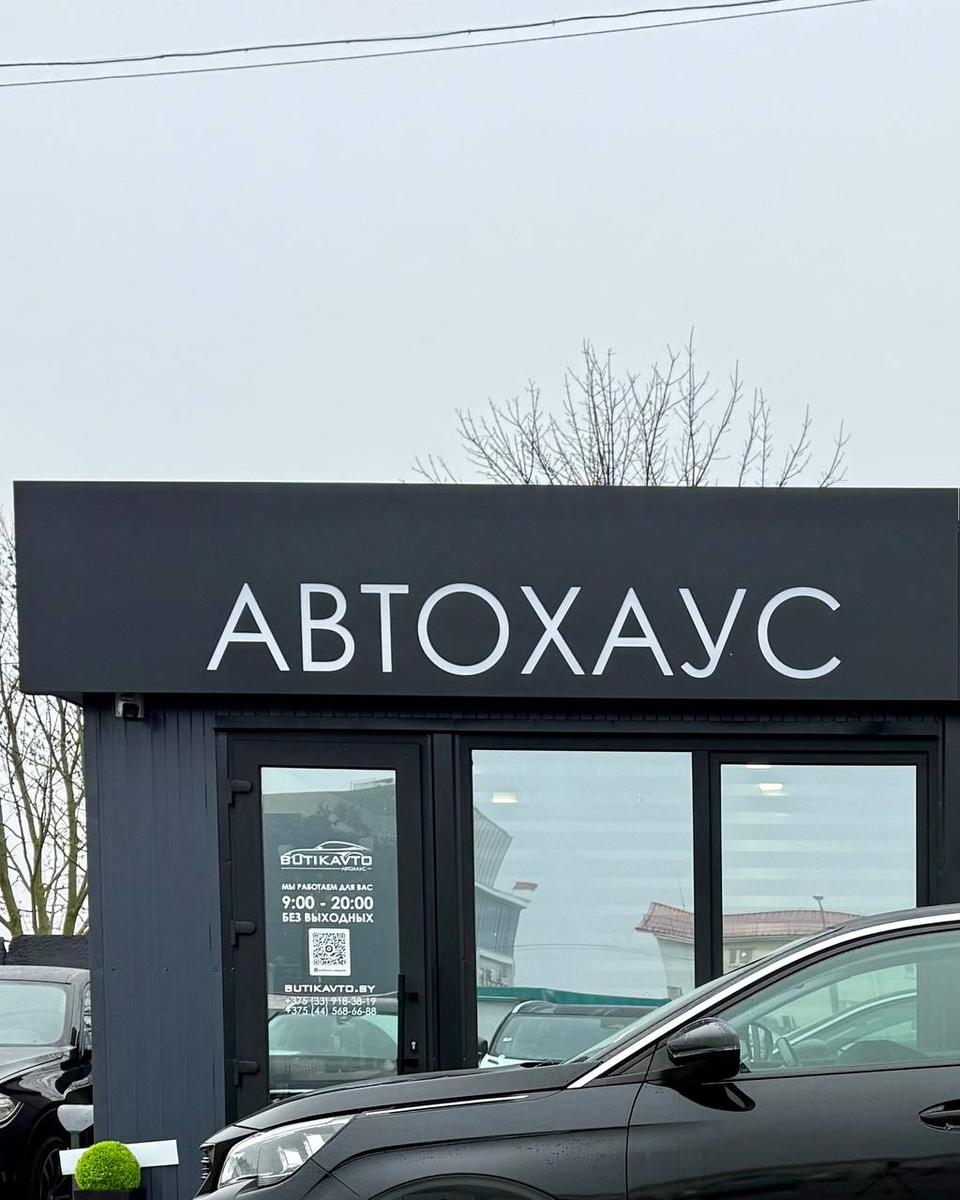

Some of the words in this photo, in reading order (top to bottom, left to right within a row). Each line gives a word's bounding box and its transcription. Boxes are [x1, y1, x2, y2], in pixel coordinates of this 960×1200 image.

[206, 582, 842, 680] АВТОХАУС
[280, 855, 373, 866] BUTIKAVTO
[281, 883, 296, 891] МЫ
[297, 883, 338, 891] РАБОТАЕМ
[338, 883, 355, 892] ДЛЯ
[281, 895, 315, 910] 9:00
[331, 895, 374, 910] 20:00
[282, 912, 301, 923] БЕЗ
[304, 912, 374, 924] ВЫХОДНЫХ
[284, 984, 376, 993] BUTIKAVTO.BY
[285, 997, 308, 1006] +375
[311, 996, 328, 1007] (33)
[332, 997, 376, 1006] 918-38-19
[285, 1007, 308, 1016] +375
[311, 1007, 328, 1017] (44)
[332, 1007, 377, 1016] 568-66-88
